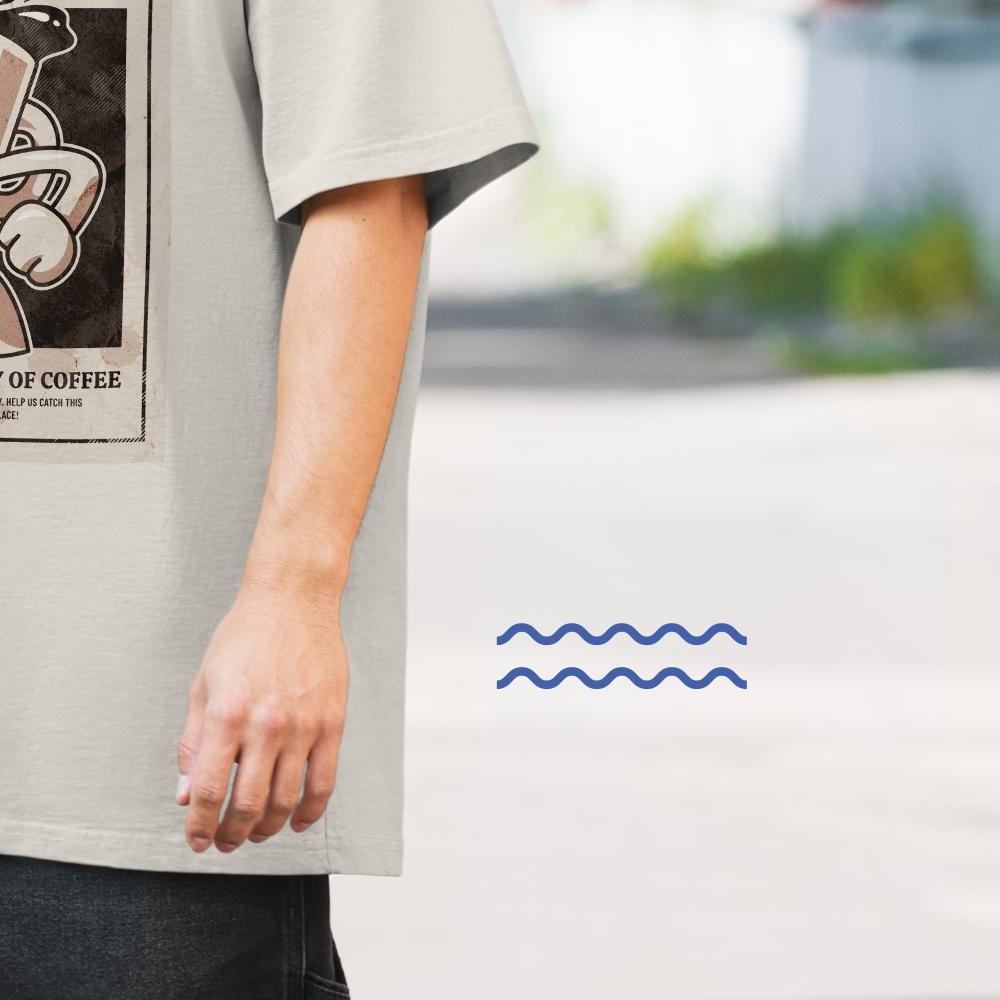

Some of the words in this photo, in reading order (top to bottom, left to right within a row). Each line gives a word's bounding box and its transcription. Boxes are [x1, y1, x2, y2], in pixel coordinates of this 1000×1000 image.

[8, 371, 36, 389] OF
[40, 371, 121, 389] COFFEE
[6, 397, 26, 407] HELP
[27, 398, 38, 407] US
[39, 398, 63, 408] CATCH
[65, 398, 83, 408] THIS
